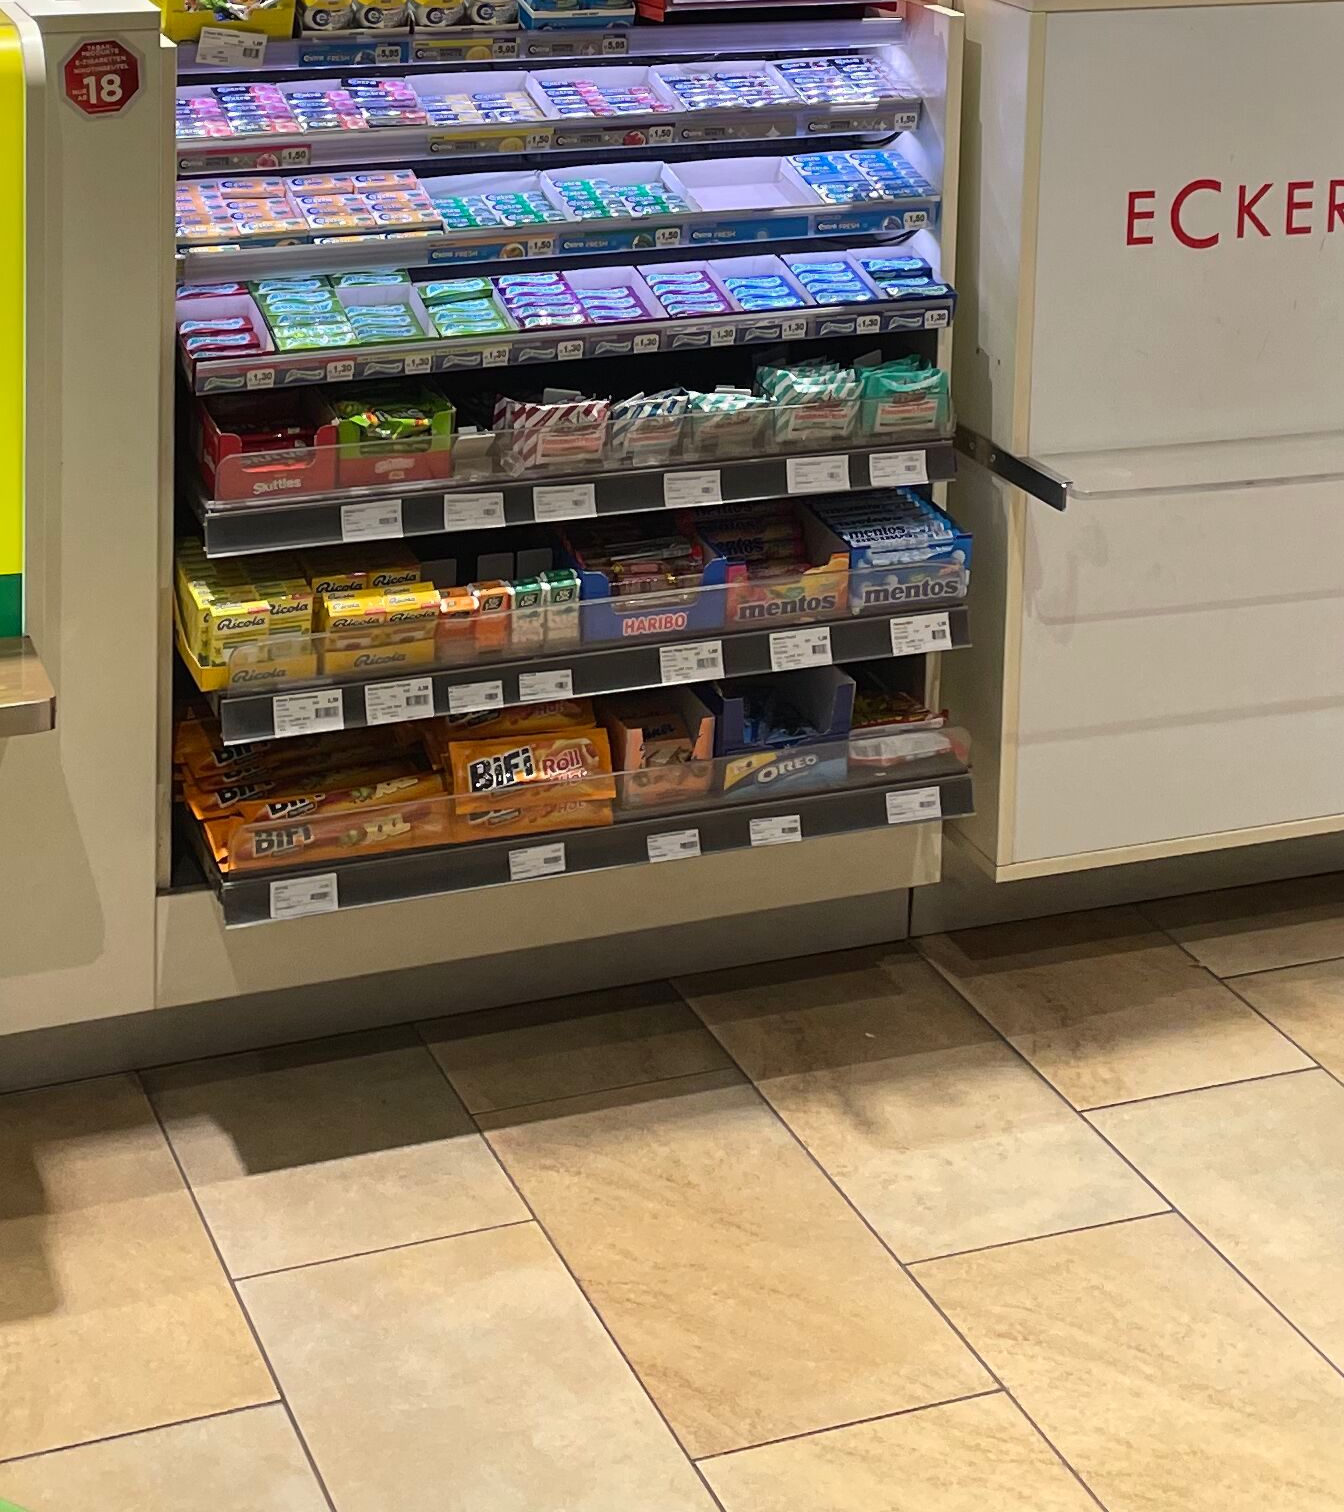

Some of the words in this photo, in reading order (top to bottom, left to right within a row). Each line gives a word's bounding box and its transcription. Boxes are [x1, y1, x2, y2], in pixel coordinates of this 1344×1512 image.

[83, 74, 122, 104] 18
[253, 477, 302, 495] Skittles
[847, 523, 906, 541] mentos
[316, 580, 363, 596] Ricola
[372, 571, 417, 587] Ricola
[863, 577, 960, 605] mentos
[738, 593, 838, 621] mentos
[217, 617, 266, 633] Ricola
[332, 616, 381, 630] Ricola
[389, 610, 436, 624] Ricola
[622, 613, 688, 636] HARIBO
[353, 651, 406, 668] Ricola
[469, 745, 534, 792] BiFi
[542, 748, 583, 778] Roll
[756, 753, 820, 784] OREO
